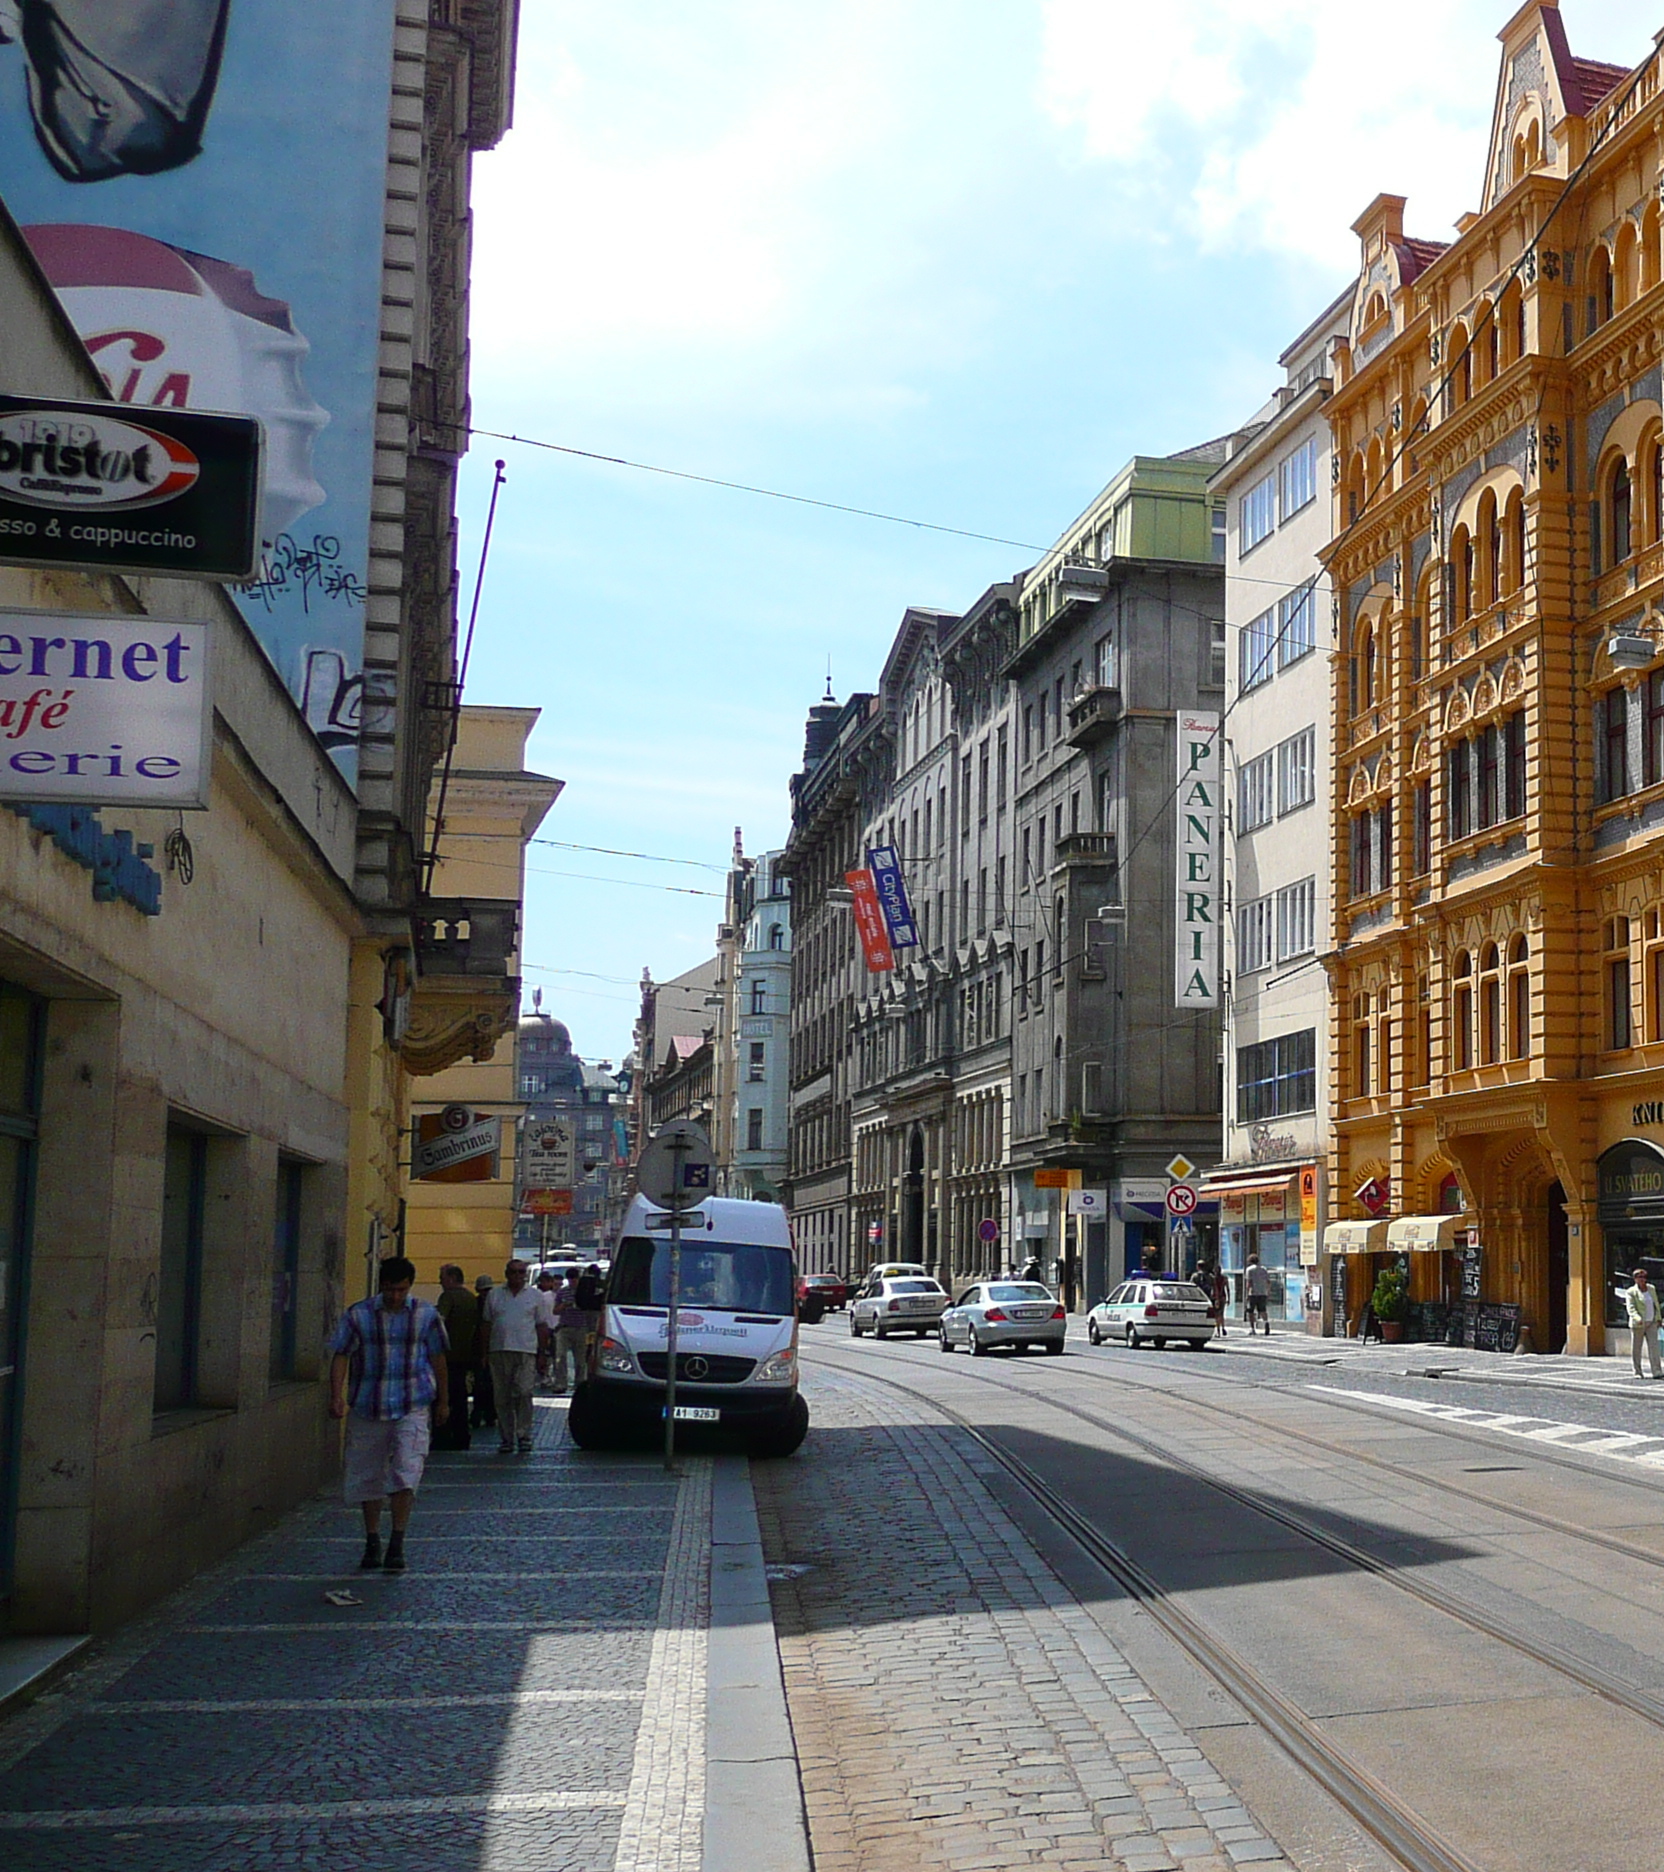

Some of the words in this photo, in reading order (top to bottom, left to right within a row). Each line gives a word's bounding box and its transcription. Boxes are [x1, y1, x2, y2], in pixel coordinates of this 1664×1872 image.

[45, 518, 61, 538] &
[70, 522, 196, 549] cappuccino
[1184, 741, 1214, 998] PANERIA
[422, 1131, 493, 1165] Gambrinus
[1616, 1168, 1662, 1192] SVATÉHO
